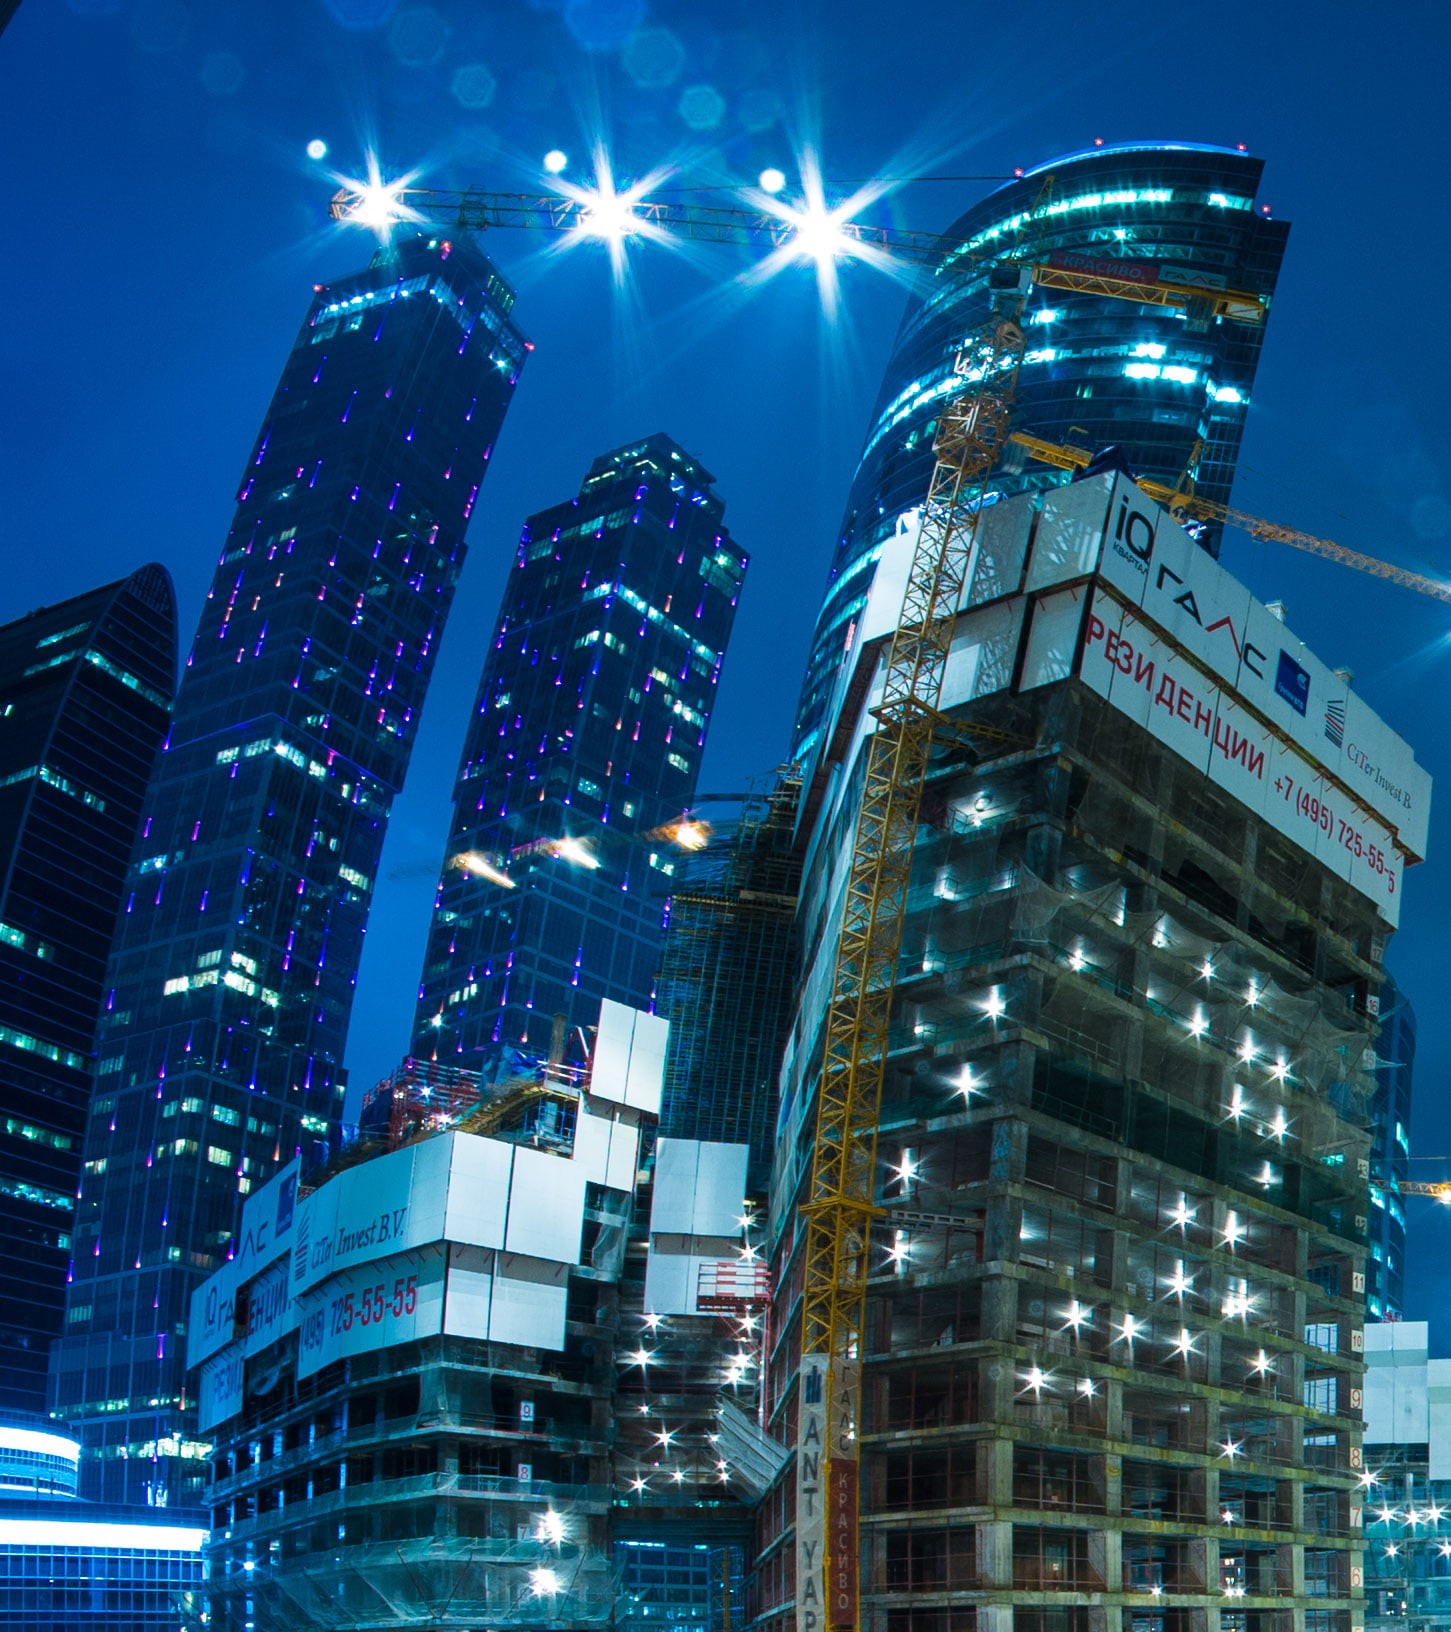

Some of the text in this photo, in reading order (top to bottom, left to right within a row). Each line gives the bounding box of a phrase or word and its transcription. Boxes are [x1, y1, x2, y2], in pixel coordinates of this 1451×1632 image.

[1085, 613, 1265, 780] РЕЗИДЕНЦИИ
[1274, 775, 1293, 802] +7
[1296, 786, 1334, 840] (495)
[1374, 766, 1402, 809] Invest
[335, 1220, 376, 1257] Invest
[378, 1207, 407, 1244] B.V.
[331, 1274, 418, 1338] 725-55-55
[1353, 1334, 1362, 1348] 10
[1352, 1389, 1361, 1409] 9
[523, 1404, 531, 1418] 9
[1352, 1448, 1360, 1468] 8
[520, 1466, 529, 1480] 8
[1352, 1507, 1361, 1528] 7
[1351, 1567, 1361, 1587] 6
